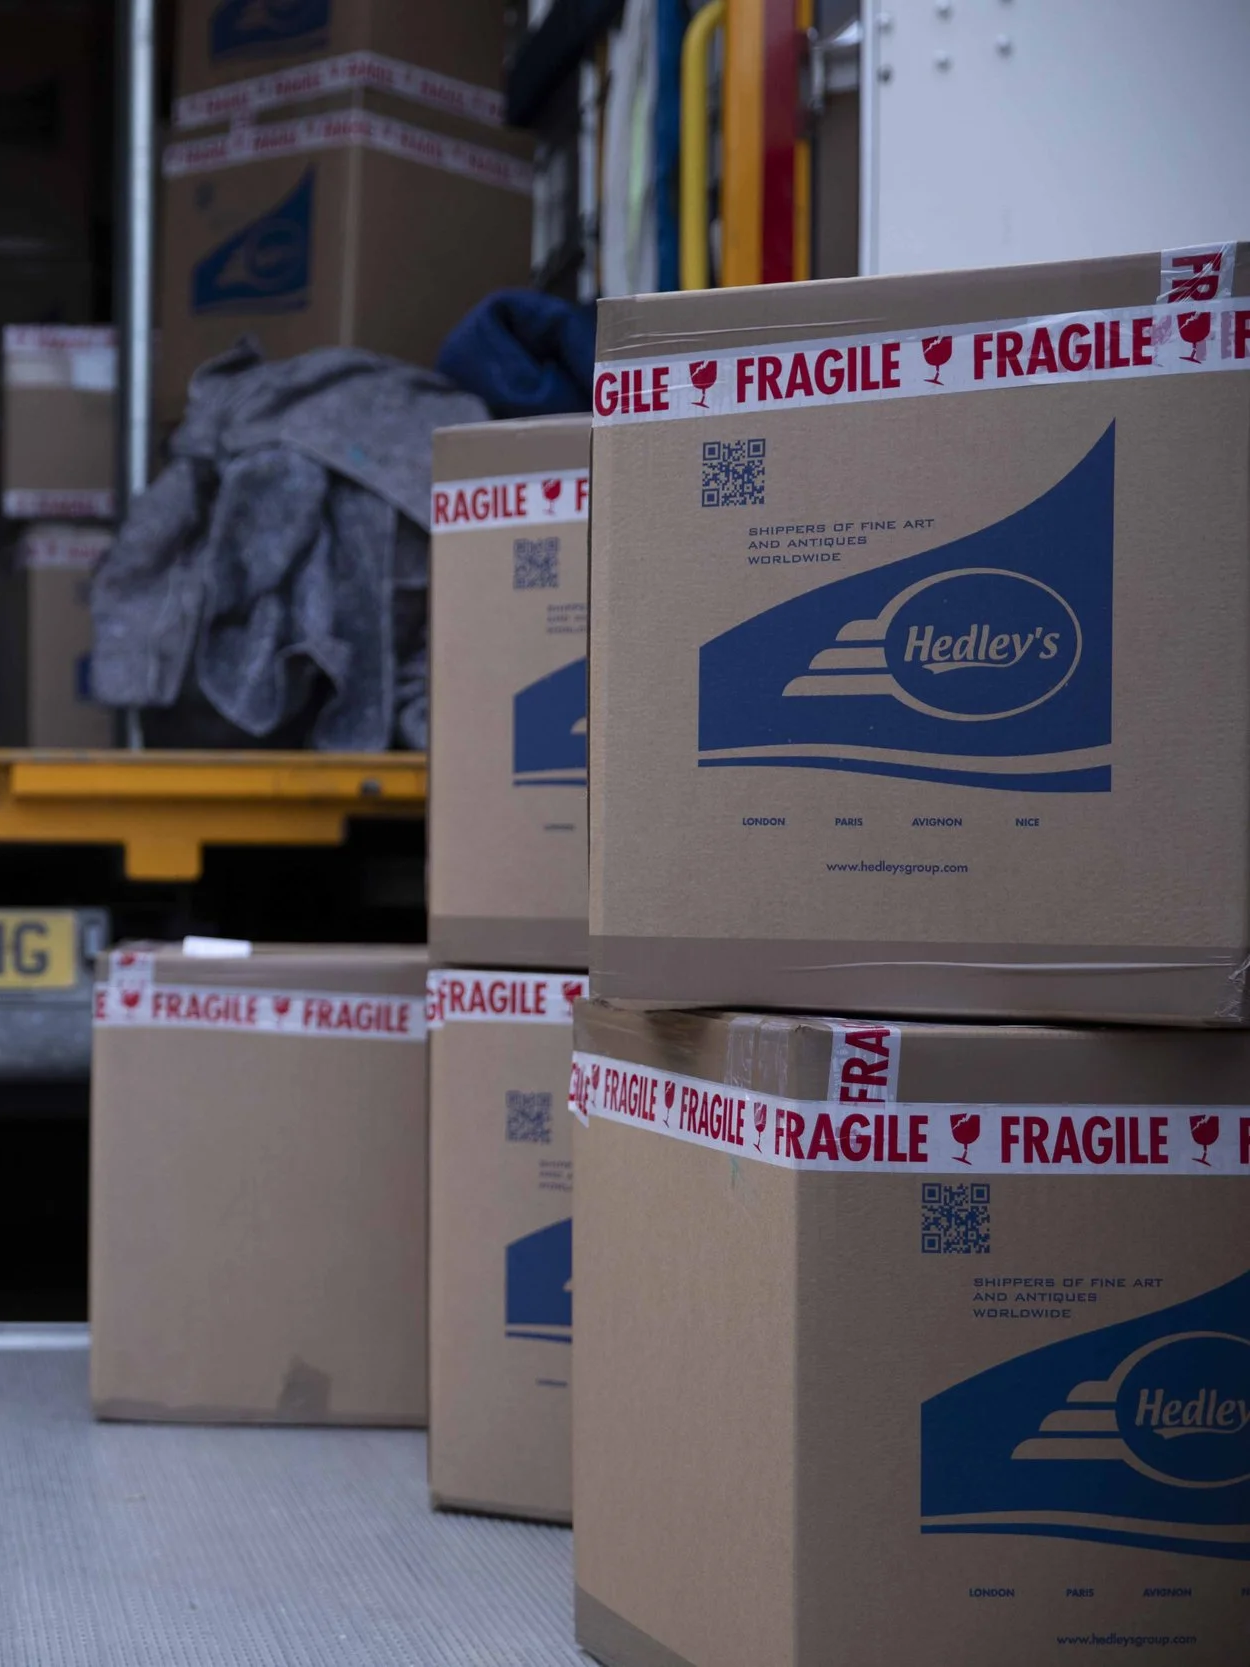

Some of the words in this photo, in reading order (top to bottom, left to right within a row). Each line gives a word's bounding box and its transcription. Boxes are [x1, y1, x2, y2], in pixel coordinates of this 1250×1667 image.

[595, 366, 670, 417] GILE
[737, 342, 901, 403] FRAGILE
[973, 317, 1154, 380] FRAGILE
[434, 482, 528, 525] RAGILE
[748, 524, 826, 536] SHIPPERS
[833, 522, 855, 532] OF
[861, 520, 897, 530] FINE
[903, 518, 935, 529] ART
[748, 540, 781, 550] AND
[787, 536, 868, 548] ANTIQUES
[748, 552, 841, 565] WORLDWIDE
[904, 624, 1060, 674] Hedley's
[742, 817, 786, 826] LONDON
[835, 817, 863, 827] PARIS
[912, 817, 963, 827] AVIGNON
[1015, 818, 1040, 827] NICE
[826, 860, 969, 875] www.hedleysgroup.com
[441, 980, 547, 1014] FRAGILE
[152, 992, 257, 1025] FRAGILE
[303, 1000, 410, 1034] FRAGILE
[603, 1068, 658, 1122] FRAGILE
[679, 1086, 746, 1146] FRAGILE
[774, 1108, 929, 1162] FRAGILE
[1001, 1115, 1169, 1164] FRAGILE
[973, 1278, 1055, 1288] SHIPPERS
[1063, 1278, 1085, 1288] OF
[1091, 1278, 1126, 1288] FINE
[1133, 1278, 1164, 1288] ART
[973, 1292, 1008, 1302] AND
[1015, 1292, 1098, 1303] ANTIQUES
[973, 1308, 1072, 1319] WORLDWIDE
[969, 1588, 1015, 1598] LONDON
[1066, 1588, 1094, 1598] PARIS
[1142, 1588, 1192, 1598] AVIGNON
[1057, 1633, 1197, 1648] www.hedleysgroup.com
